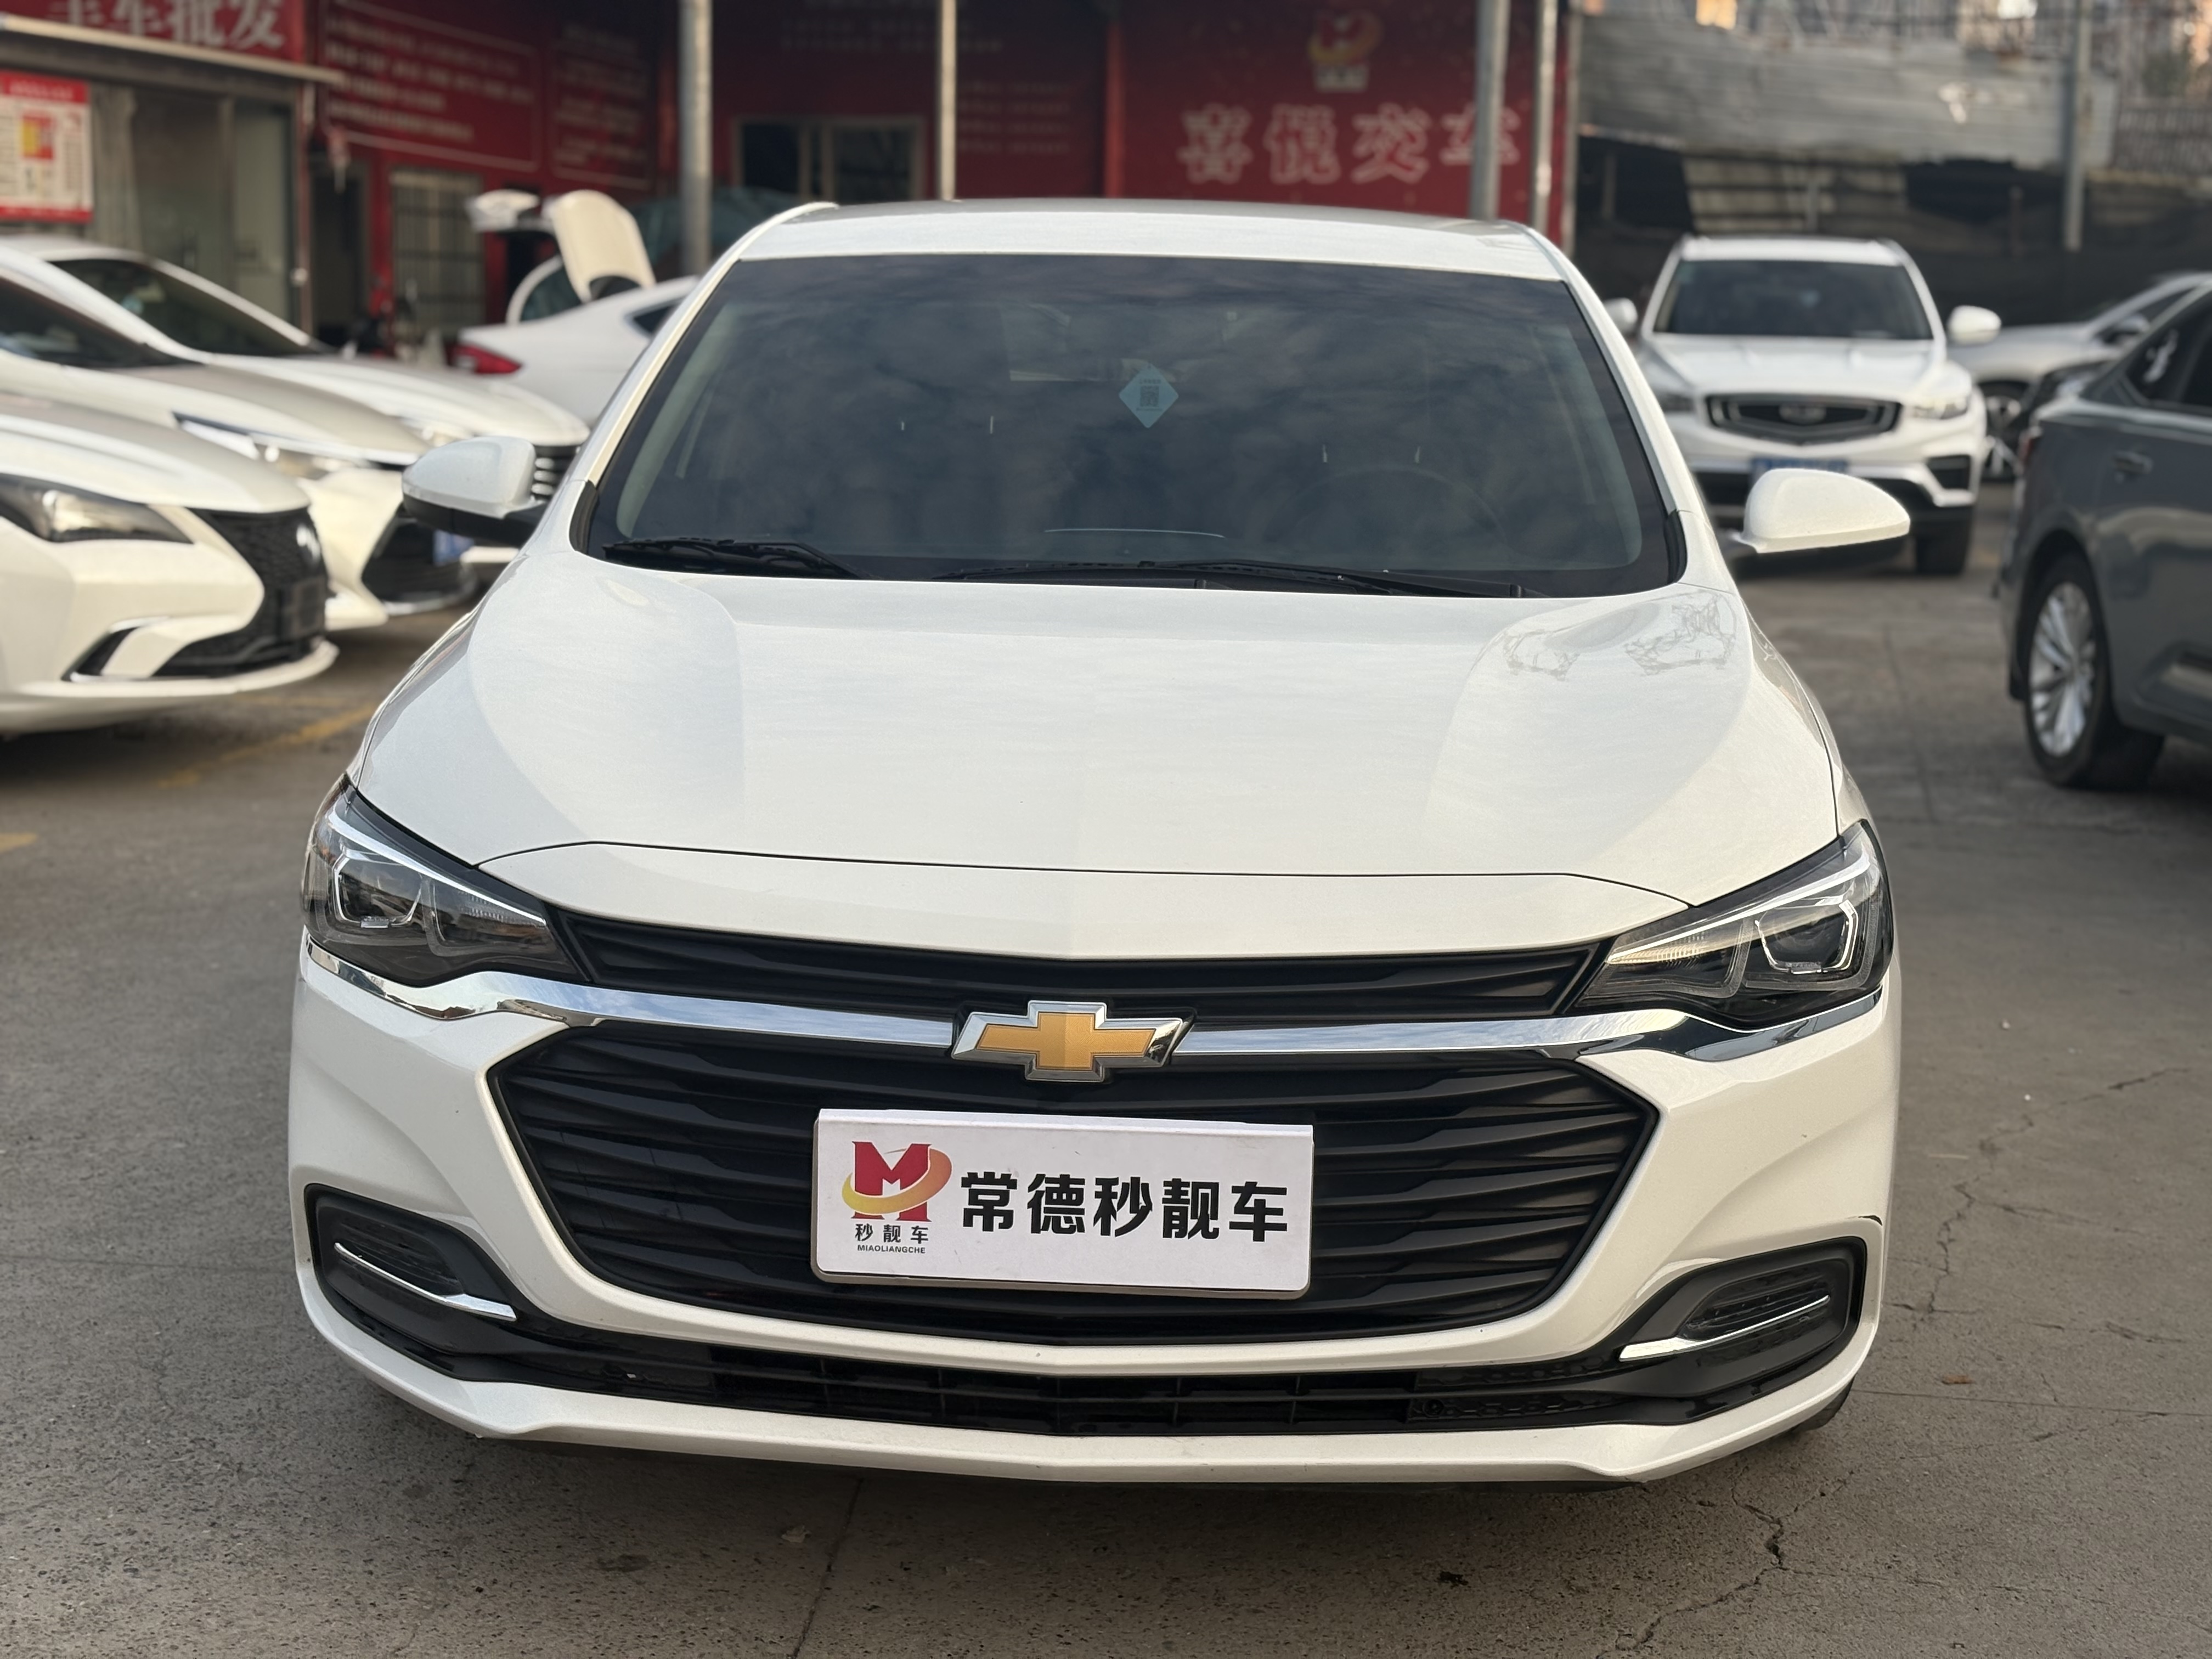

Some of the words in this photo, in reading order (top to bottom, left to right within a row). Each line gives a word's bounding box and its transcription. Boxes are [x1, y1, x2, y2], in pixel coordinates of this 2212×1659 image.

[961, 1172, 1288, 1242] 常德秒靓车
[855, 1223, 929, 1244] 秒靓车
[857, 1244, 926, 1254] MIAOLIANGCHE
